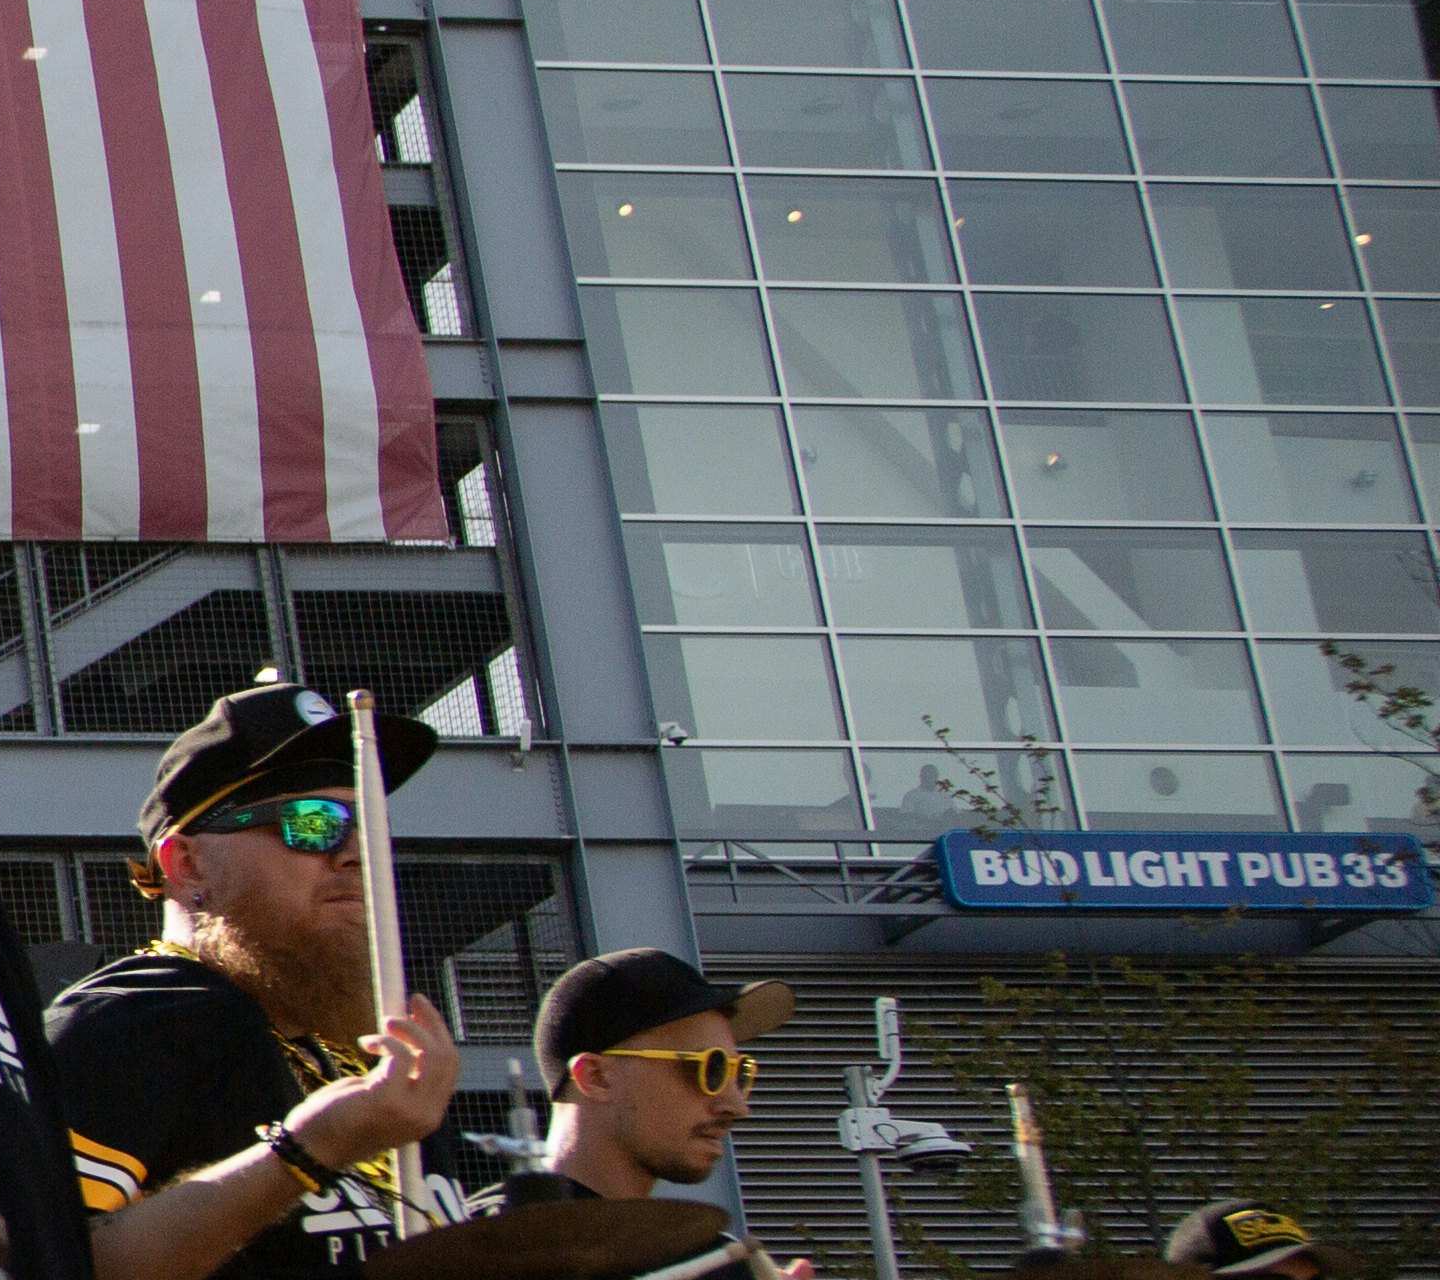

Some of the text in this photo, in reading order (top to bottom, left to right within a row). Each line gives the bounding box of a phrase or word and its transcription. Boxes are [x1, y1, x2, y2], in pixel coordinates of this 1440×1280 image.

[969, 849, 1408, 889] BUD LIGHT PUB 33
